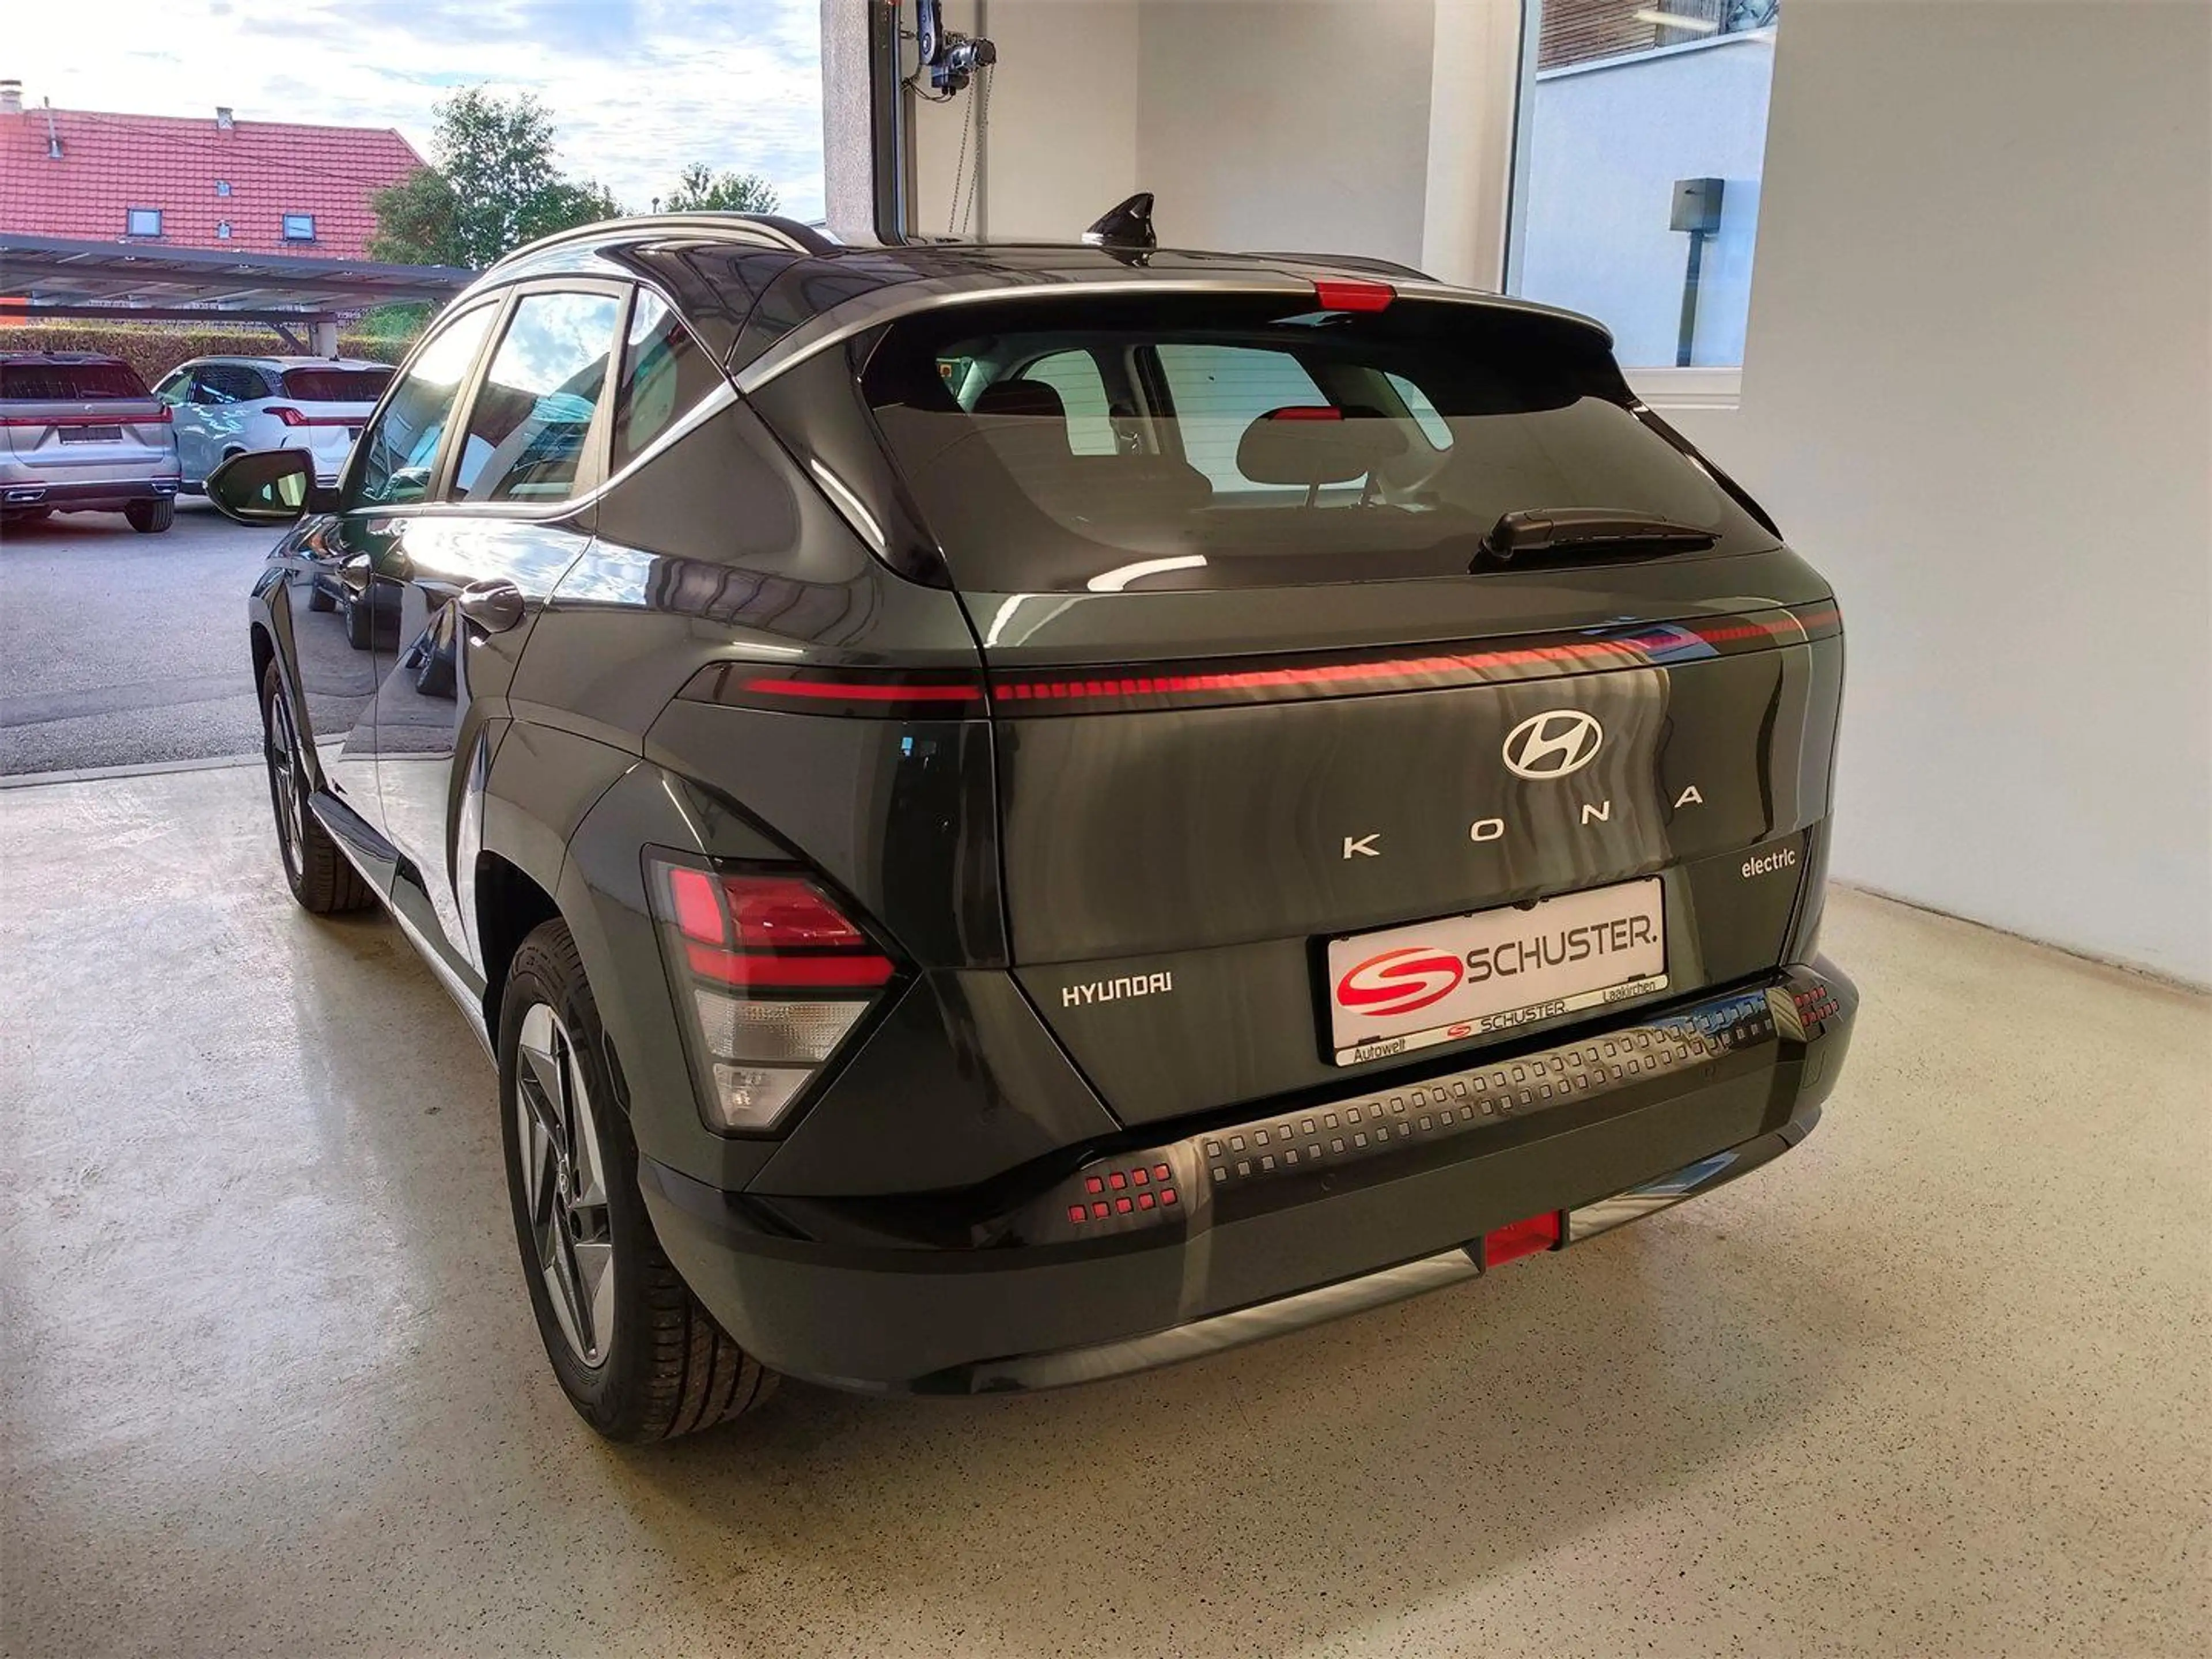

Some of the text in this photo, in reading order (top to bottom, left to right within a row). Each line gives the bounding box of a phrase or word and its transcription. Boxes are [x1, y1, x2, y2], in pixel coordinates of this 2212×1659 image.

[1741, 848, 1796, 878] electric
[1062, 972, 1172, 1007] HYUNDAI
[1602, 981, 1656, 1002] Laakirchen
